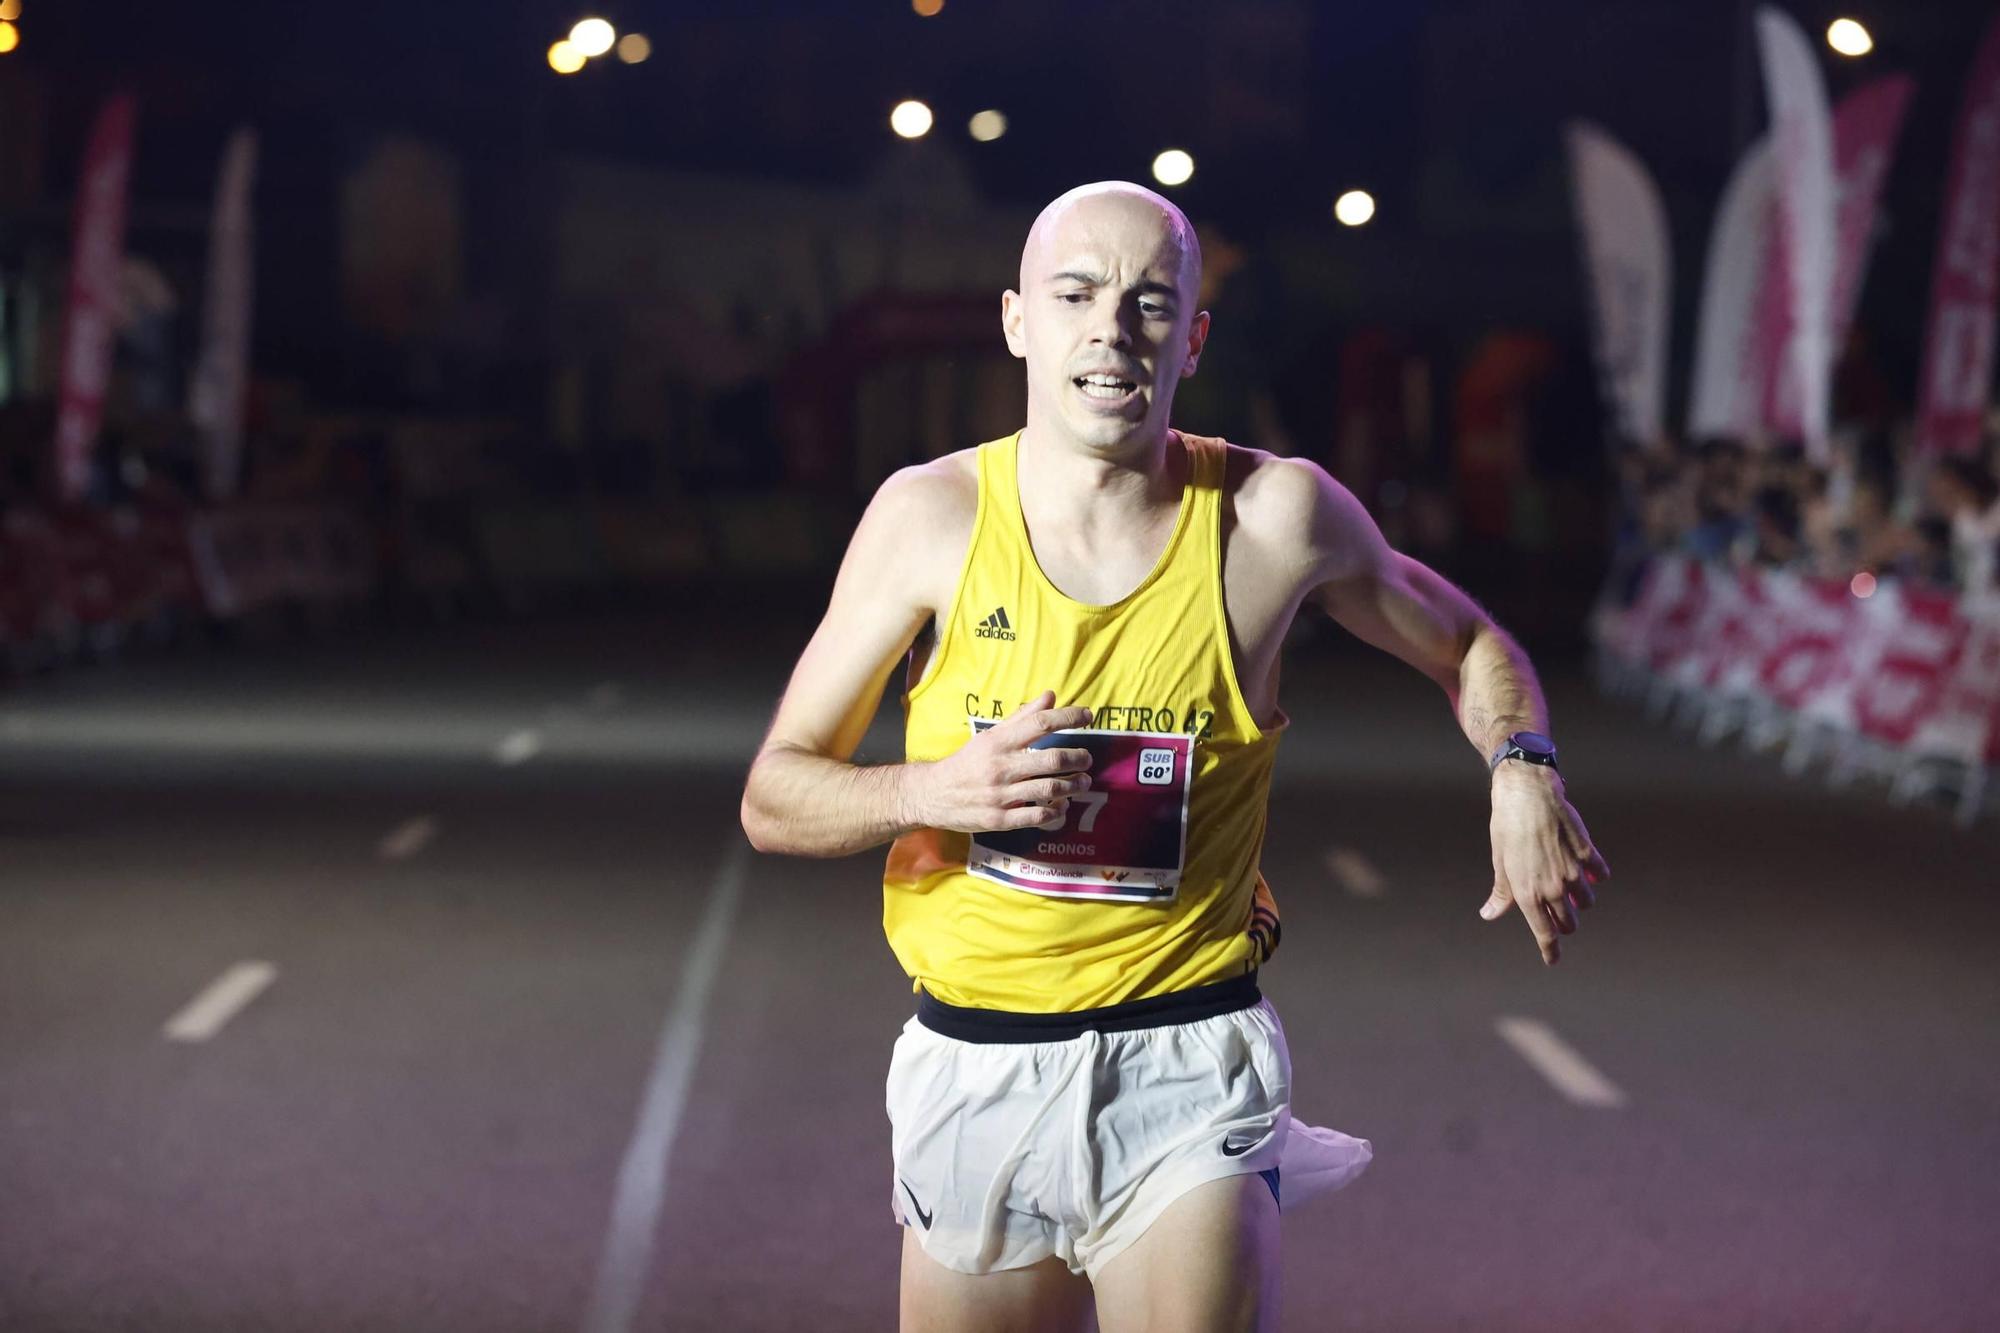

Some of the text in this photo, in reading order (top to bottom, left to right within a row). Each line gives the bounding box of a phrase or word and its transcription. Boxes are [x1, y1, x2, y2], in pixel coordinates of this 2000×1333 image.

[975, 626, 1016, 641] adidas
[1183, 708, 1215, 738] 42
[1143, 753, 1171, 763] SUB
[1143, 766, 1171, 779] 60'
[1038, 842, 1096, 856] CRONOS
